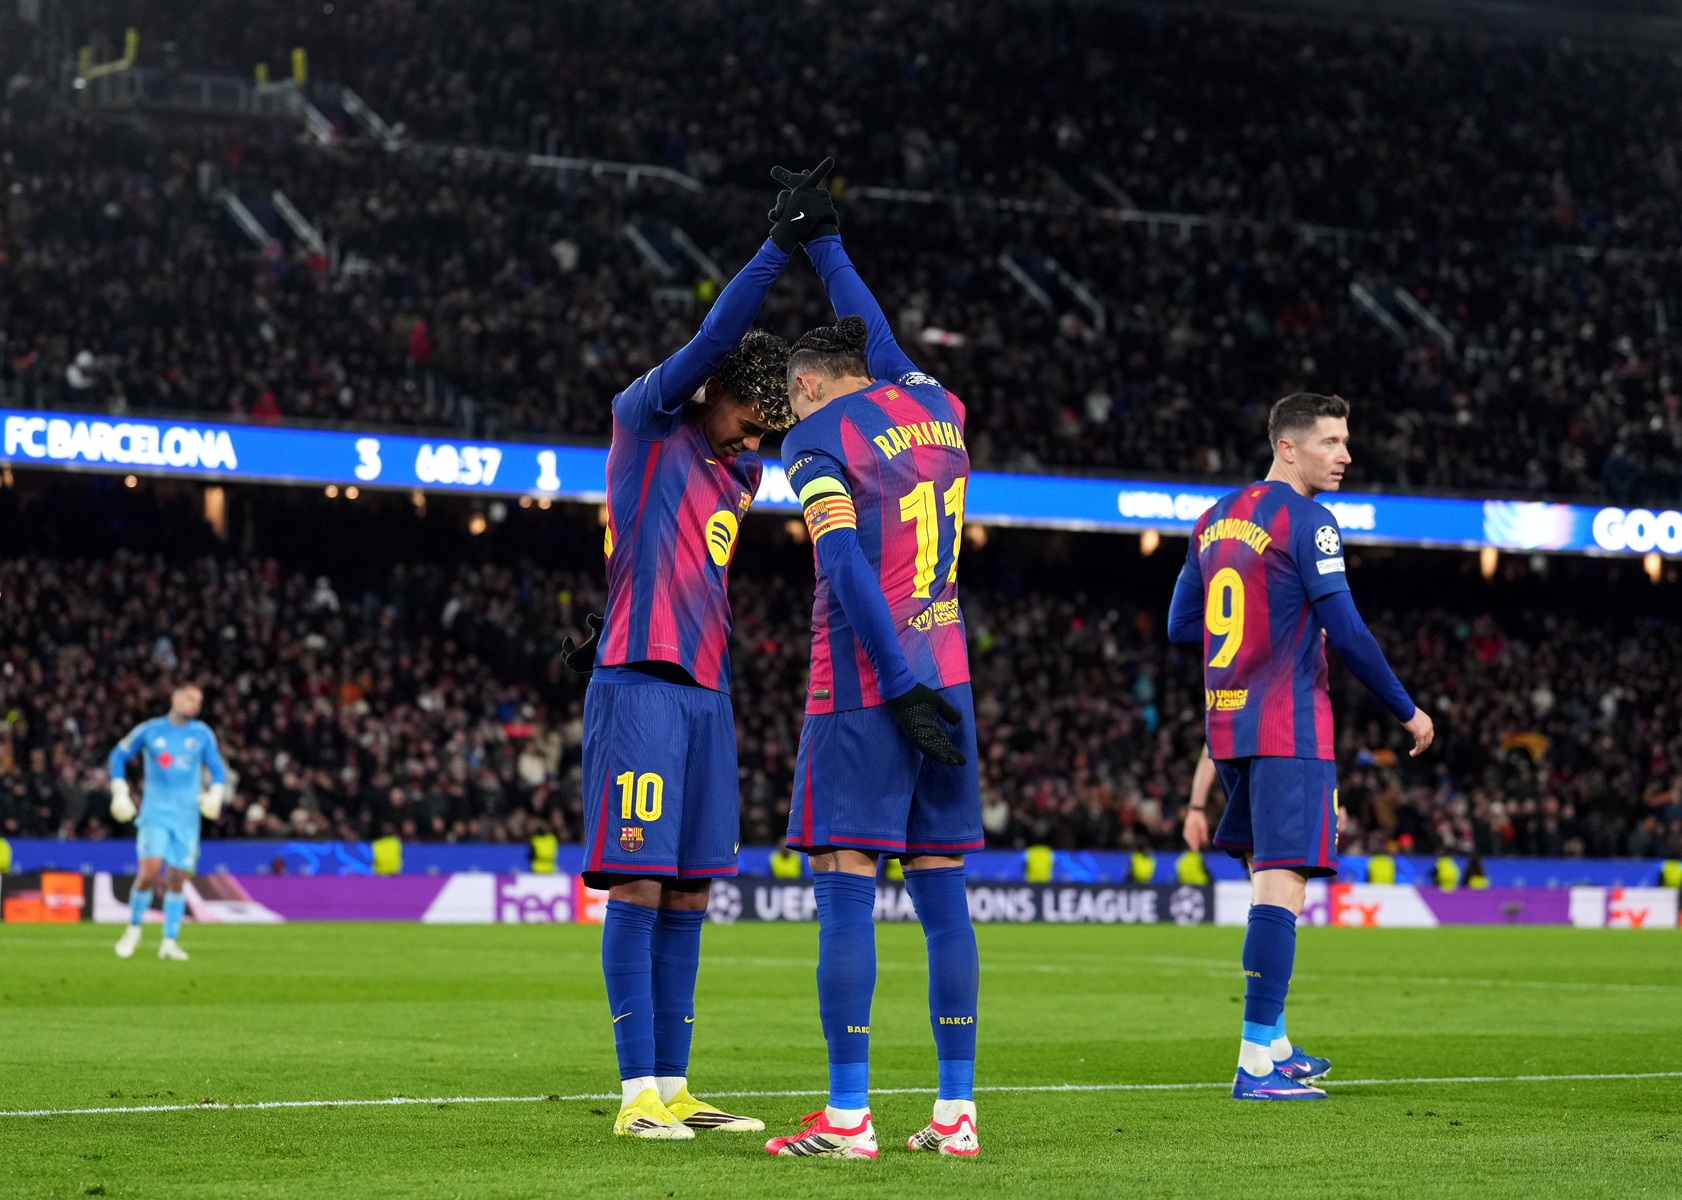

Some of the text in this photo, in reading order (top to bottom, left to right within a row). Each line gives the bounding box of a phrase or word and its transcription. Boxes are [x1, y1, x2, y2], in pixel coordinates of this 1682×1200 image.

[5, 416, 237, 470] FC BARCELONA
[356, 438, 382, 481] 3
[536, 450, 561, 491] 1
[899, 477, 966, 598] 11
[1205, 567, 1245, 668] 9
[616, 771, 664, 822] 10
[754, 886, 816, 921] UEF
[1042, 888, 1158, 922] LEAGUE
[939, 1016, 974, 1025] BARÇA
